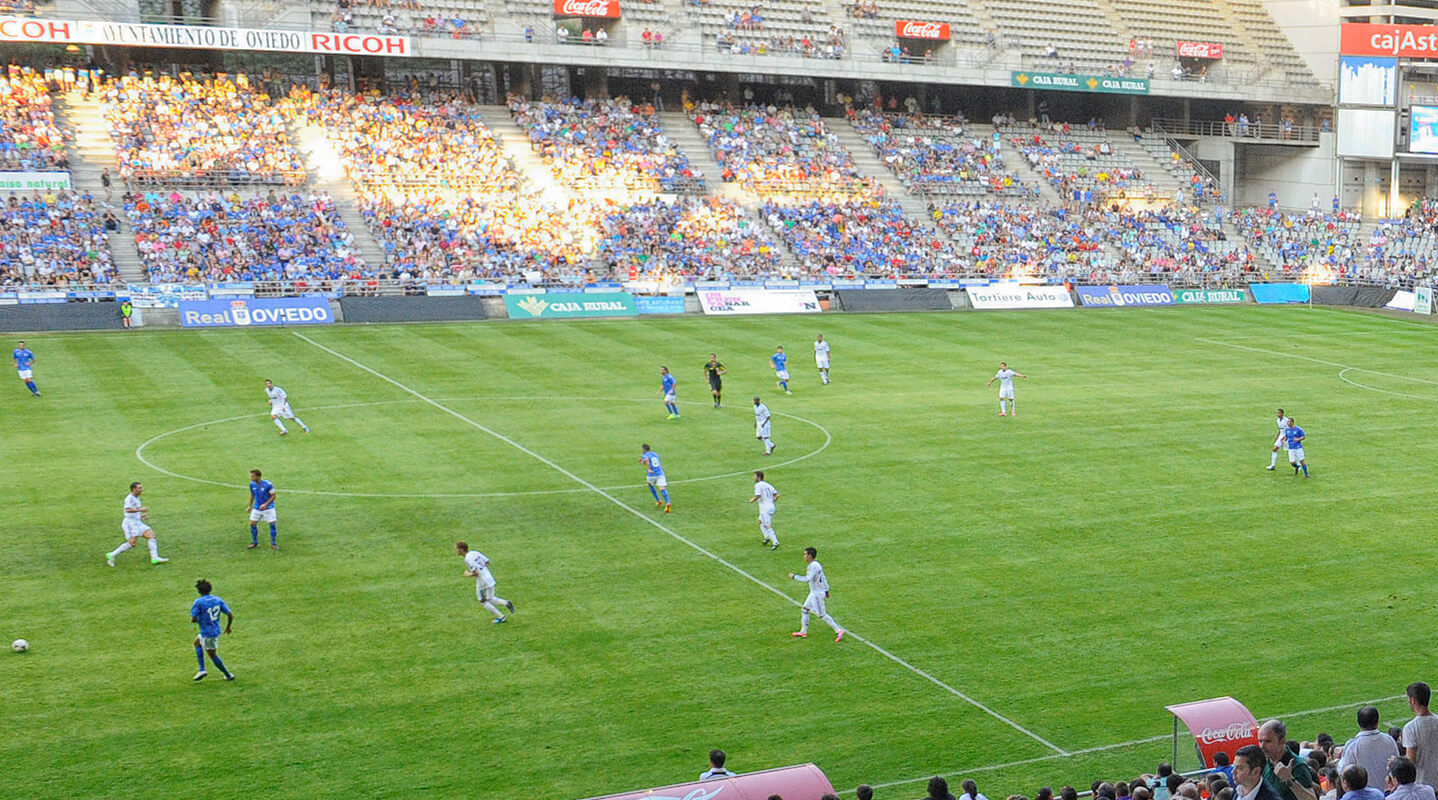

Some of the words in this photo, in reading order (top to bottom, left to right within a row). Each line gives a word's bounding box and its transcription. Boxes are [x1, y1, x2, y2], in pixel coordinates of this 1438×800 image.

[103, 25, 215, 46] AYUNTAMIENTO
[220, 30, 239, 47] DE
[246, 31, 300, 49] OVIEDO
[311, 34, 405, 54] RICOH
[1033, 75, 1051, 86] CAJA
[1053, 77, 1078, 87] RURAL
[1102, 79, 1120, 90] CAJA
[1121, 81, 1146, 91] RURAL
[972, 292, 1022, 302] Tartiere
[1027, 291, 1056, 301] Auto
[1083, 294, 1111, 305] Real
[1123, 292, 1171, 304] OVIEDO
[1207, 291, 1240, 302] RURAL
[550, 302, 582, 312] CAJA
[583, 301, 627, 311] RURAL
[184, 309, 231, 325] Real
[252, 307, 328, 323] OVIEDO
[207, 604, 220, 622] 12
